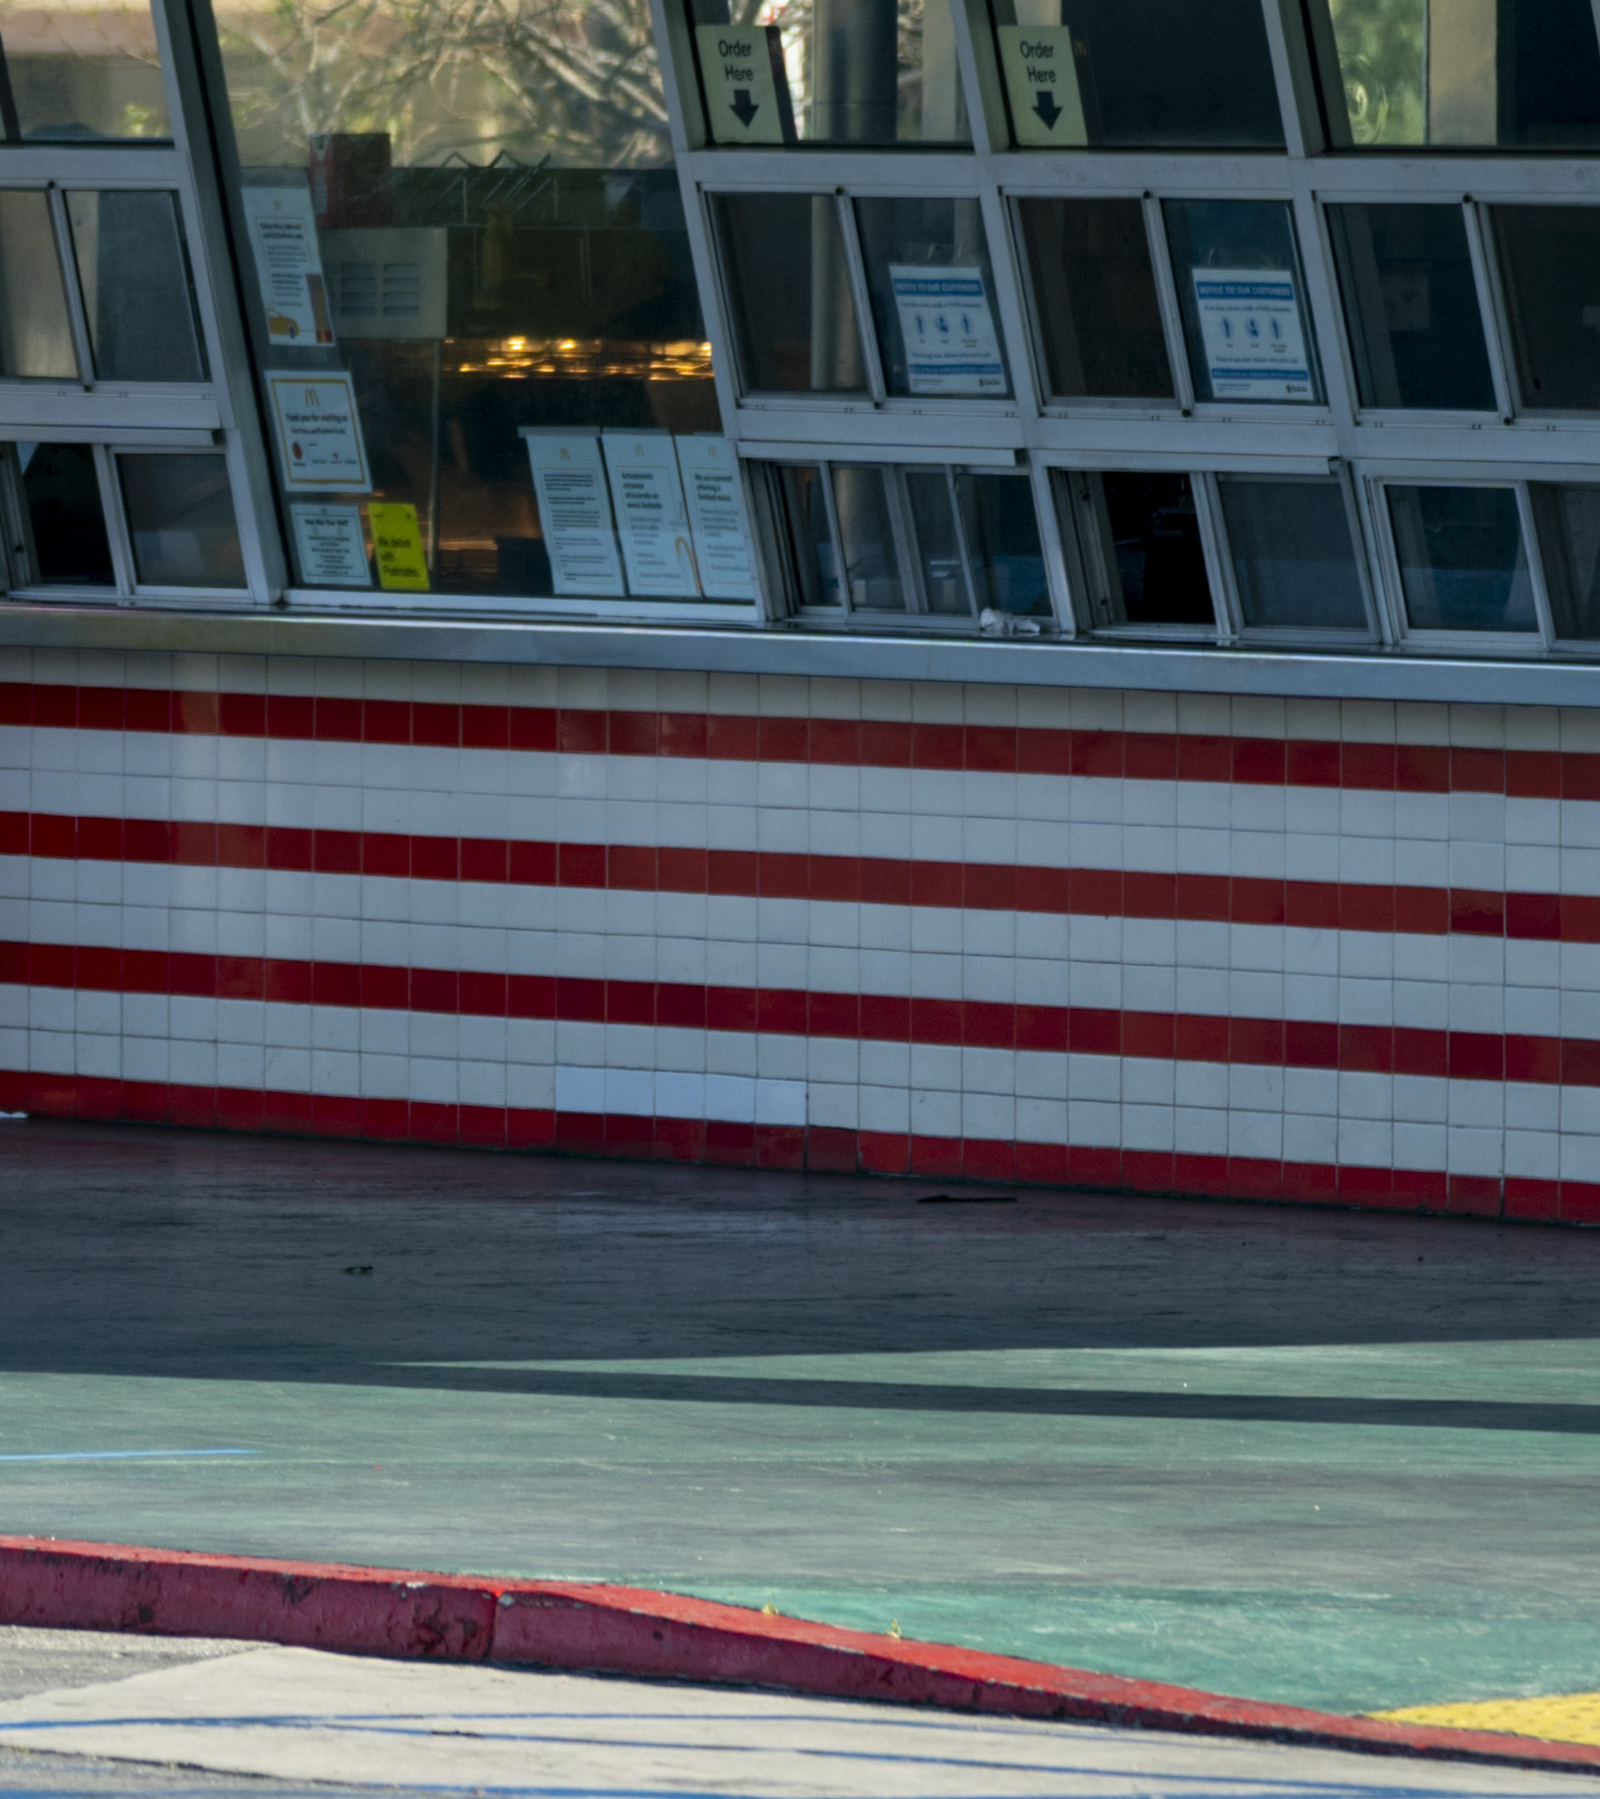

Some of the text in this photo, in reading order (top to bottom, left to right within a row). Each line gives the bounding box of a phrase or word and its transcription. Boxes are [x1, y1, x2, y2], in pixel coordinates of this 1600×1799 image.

[718, 39, 752, 57] Order
[1019, 40, 1054, 58] Order
[724, 64, 754, 81] Here
[1027, 66, 1057, 83] Here
[1199, 286, 1291, 297] NOTICE TO OUR CUSTOMERS
